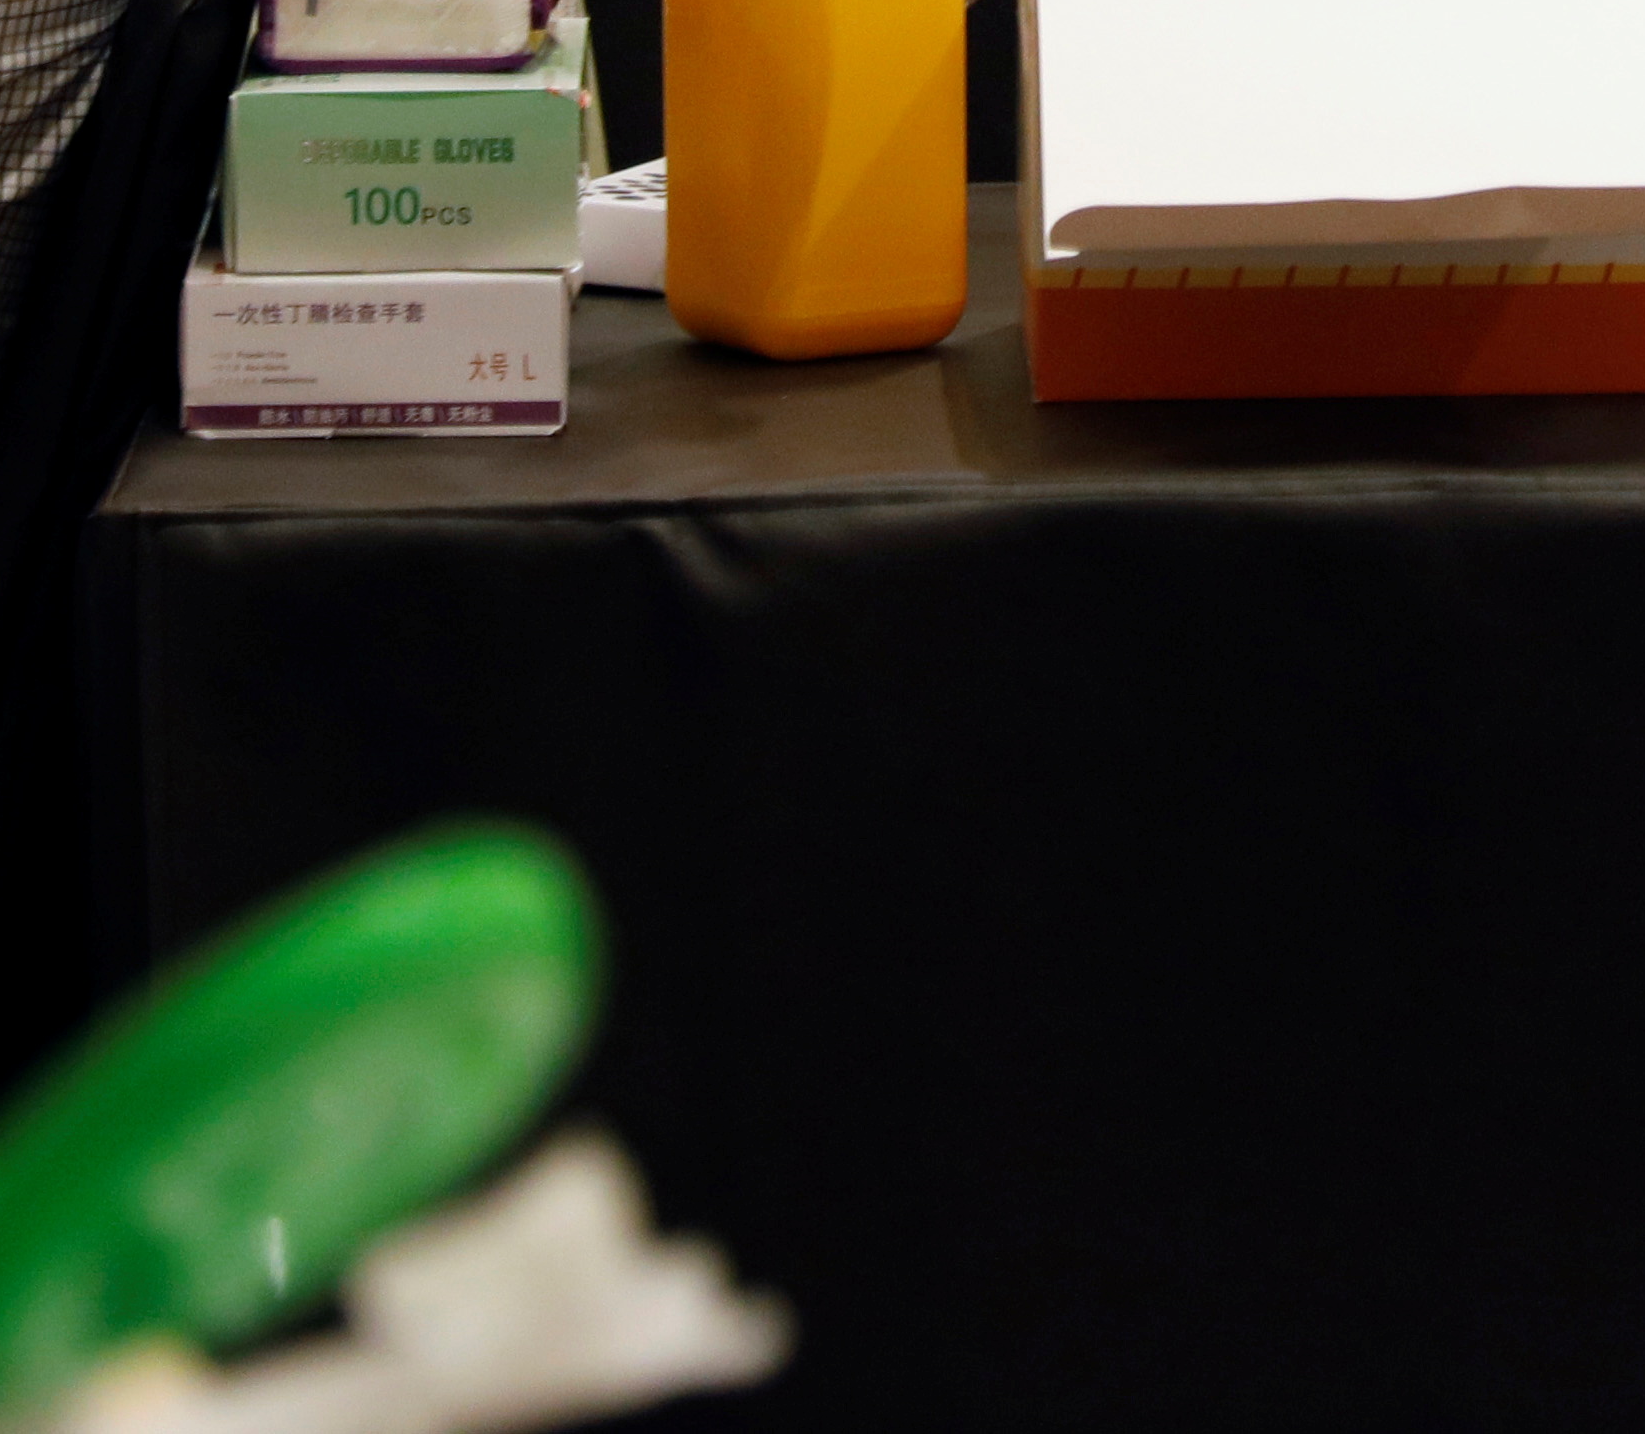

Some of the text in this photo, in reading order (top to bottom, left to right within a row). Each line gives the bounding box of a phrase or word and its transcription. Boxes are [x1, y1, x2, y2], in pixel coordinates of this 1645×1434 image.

[433, 137, 515, 163] GLOVES
[468, 352, 537, 381] 大号 L
